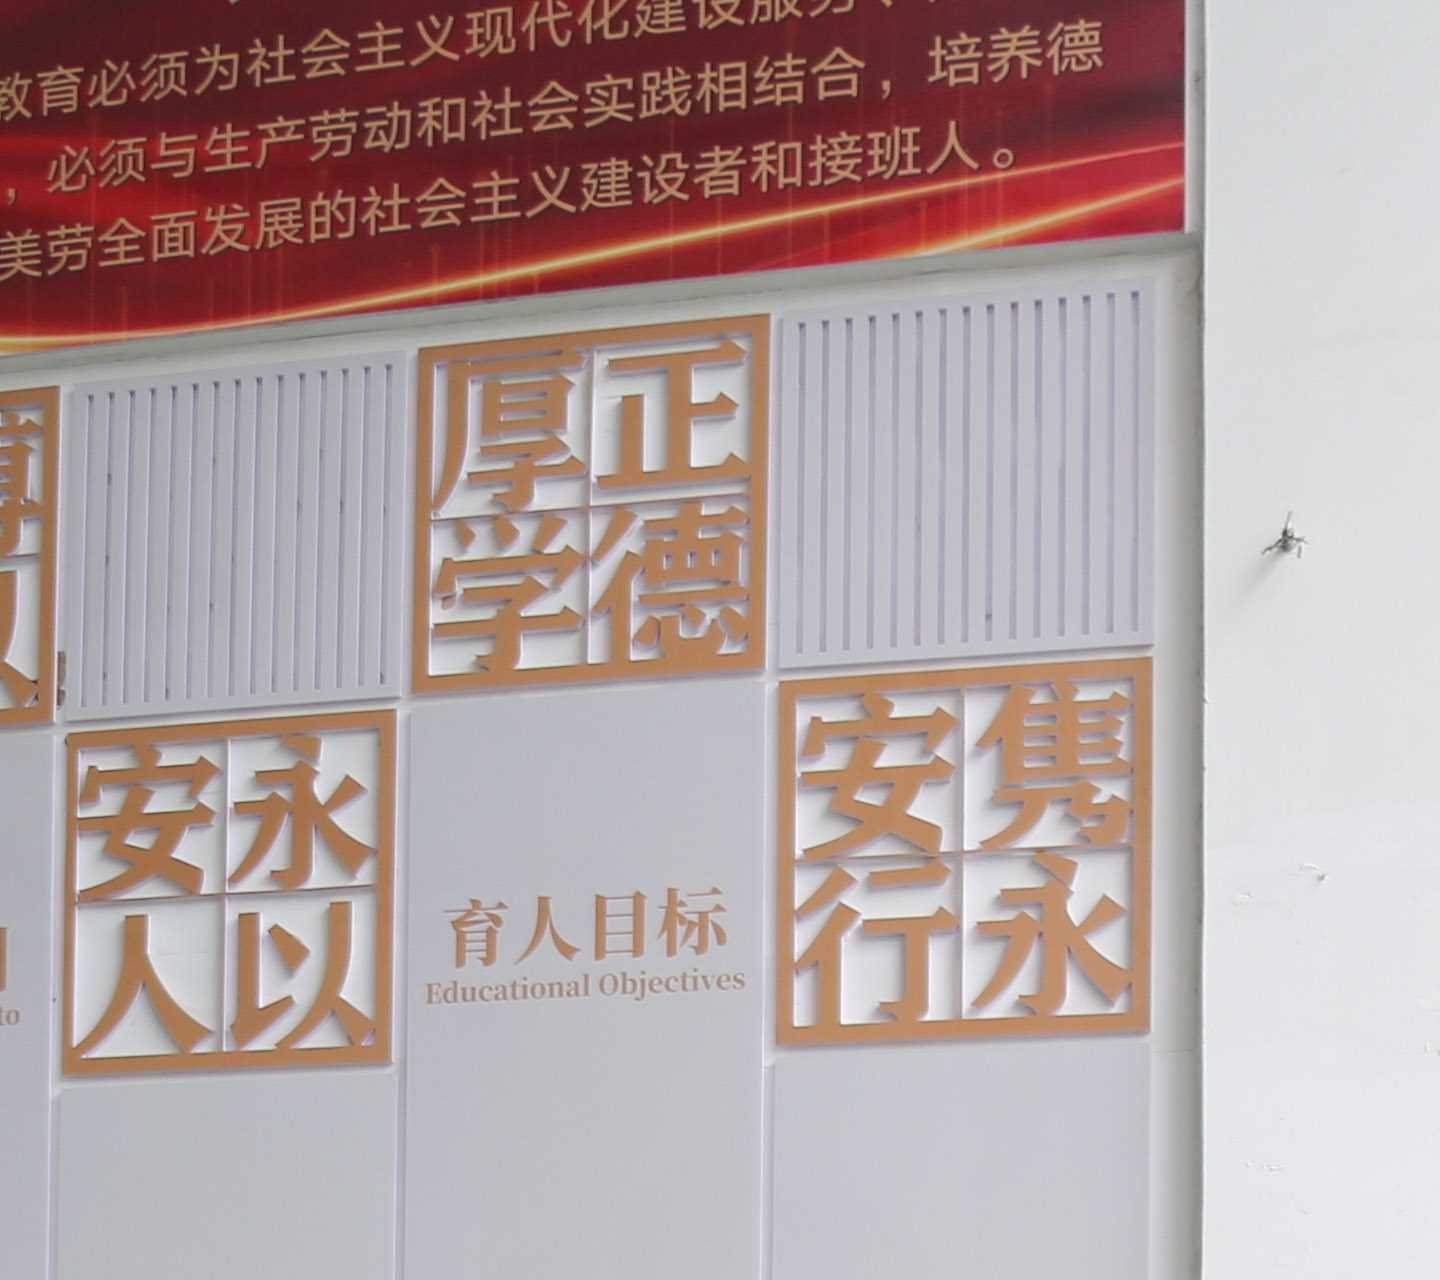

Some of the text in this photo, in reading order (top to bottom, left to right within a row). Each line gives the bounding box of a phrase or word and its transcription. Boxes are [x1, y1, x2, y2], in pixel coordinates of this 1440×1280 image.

[443, 886, 728, 970] 育人目标
[425, 968, 747, 1006] Educational Objectives
